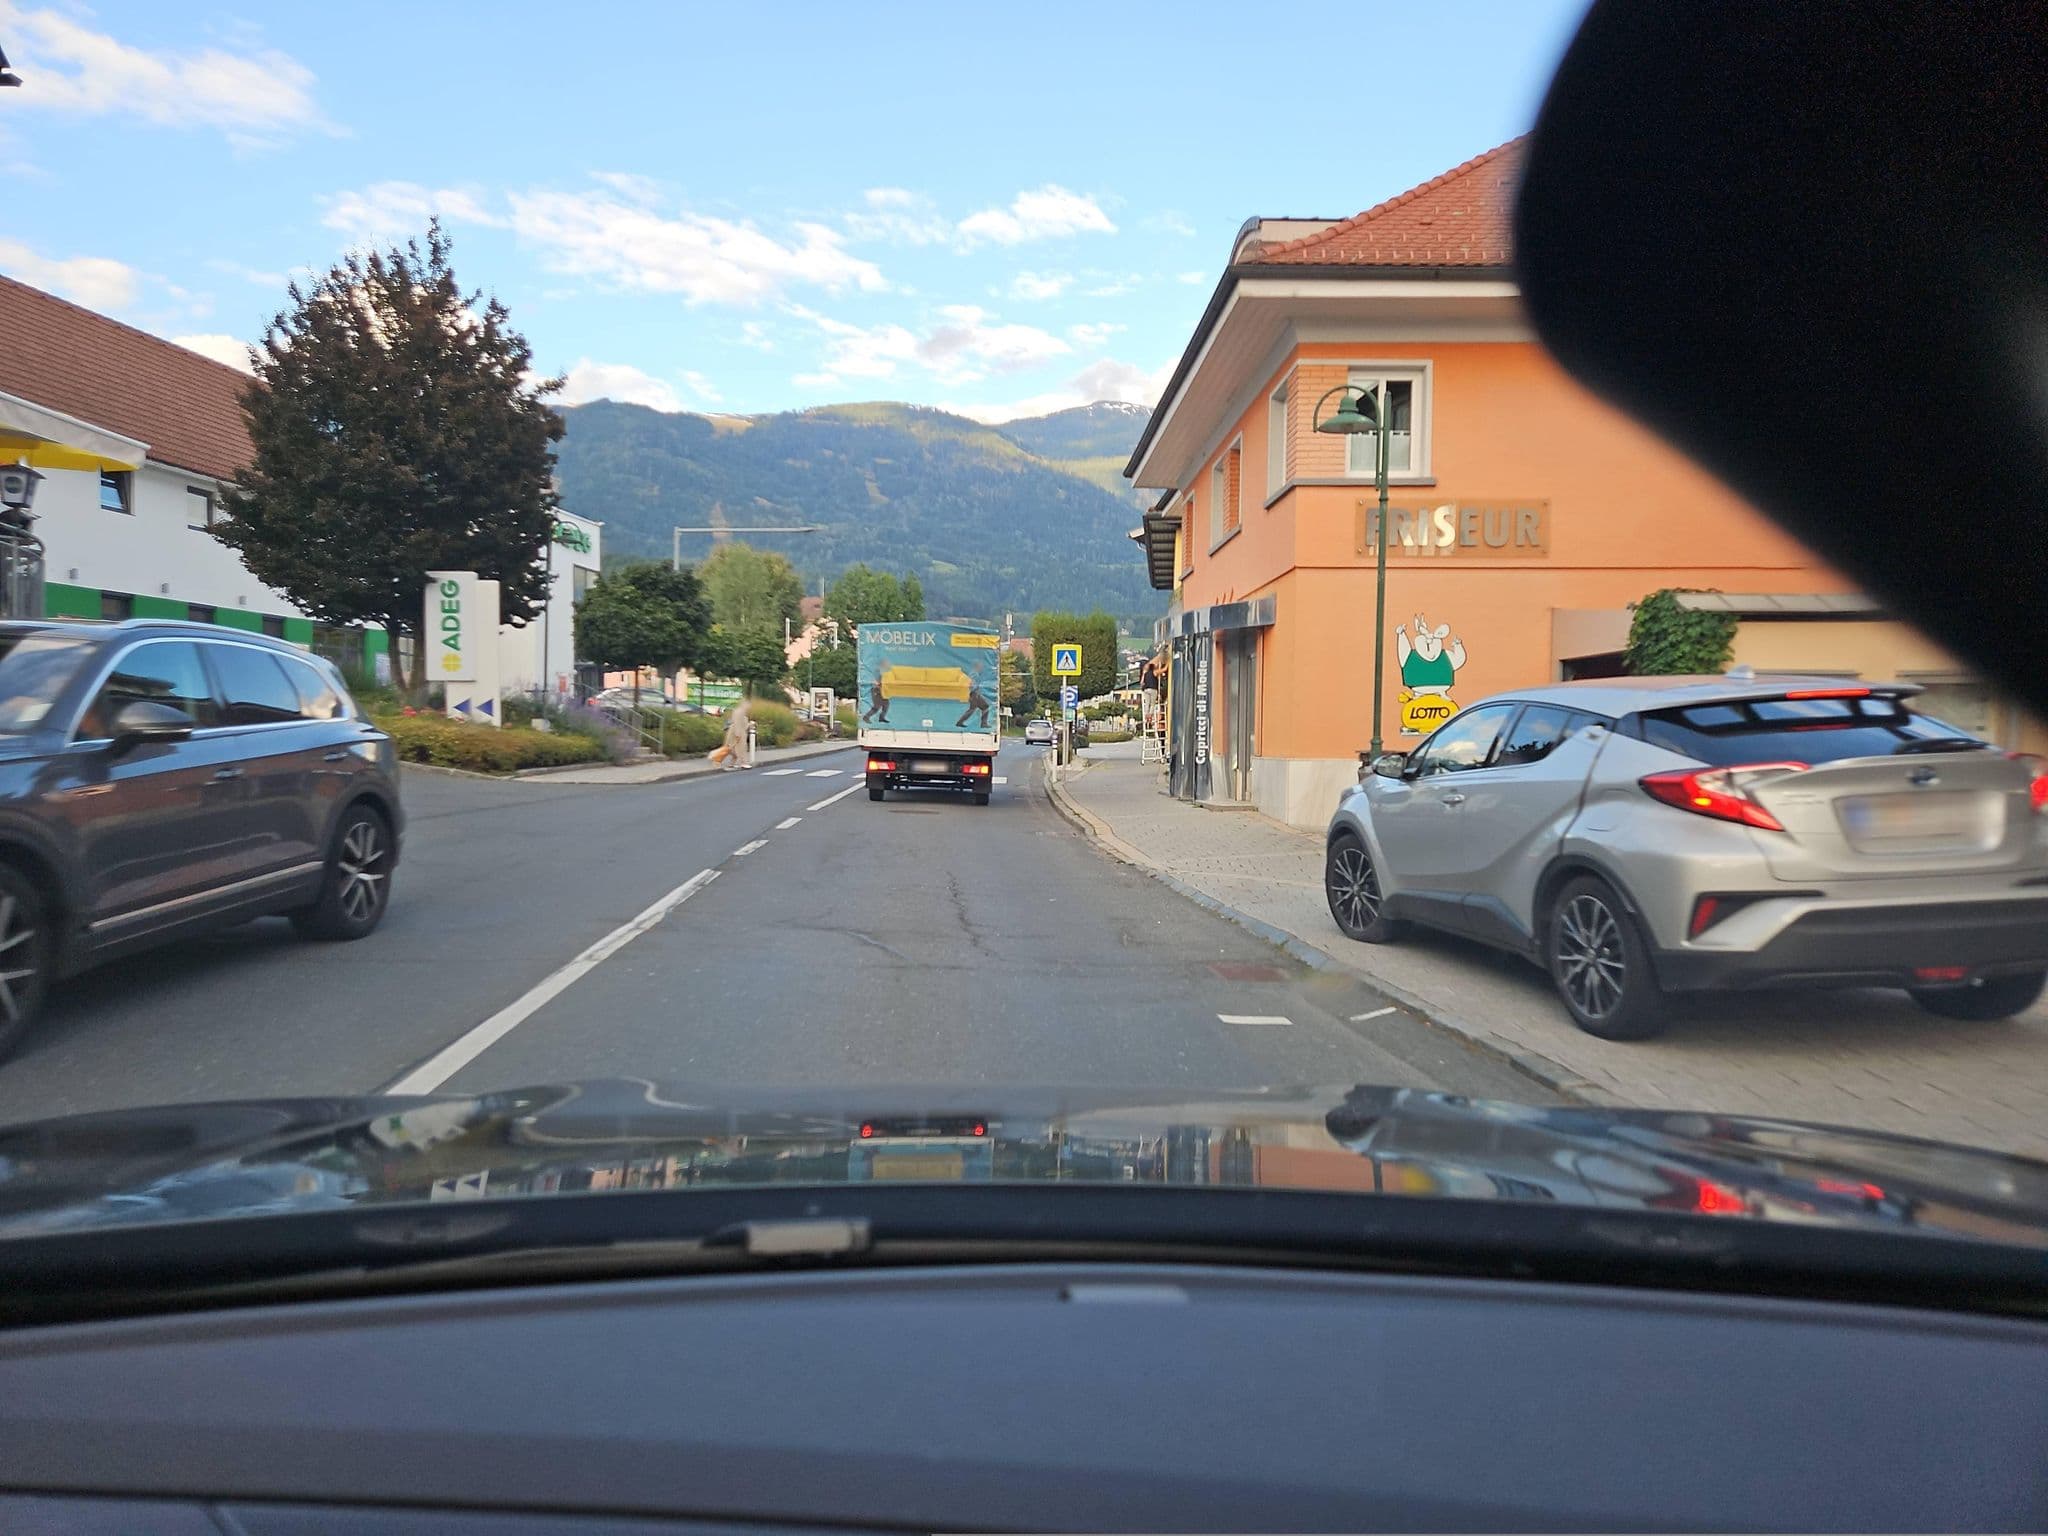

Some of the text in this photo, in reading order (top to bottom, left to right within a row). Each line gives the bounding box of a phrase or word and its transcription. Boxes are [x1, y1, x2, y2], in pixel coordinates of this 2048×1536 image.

[1365, 504, 1541, 548] FRISEUR
[440, 579, 461, 652] ADEG
[865, 627, 937, 646] MÖBELIX
[1196, 700, 1207, 713] di
[1410, 706, 1451, 720] LOTTO
[1195, 716, 1209, 765] Capricci
